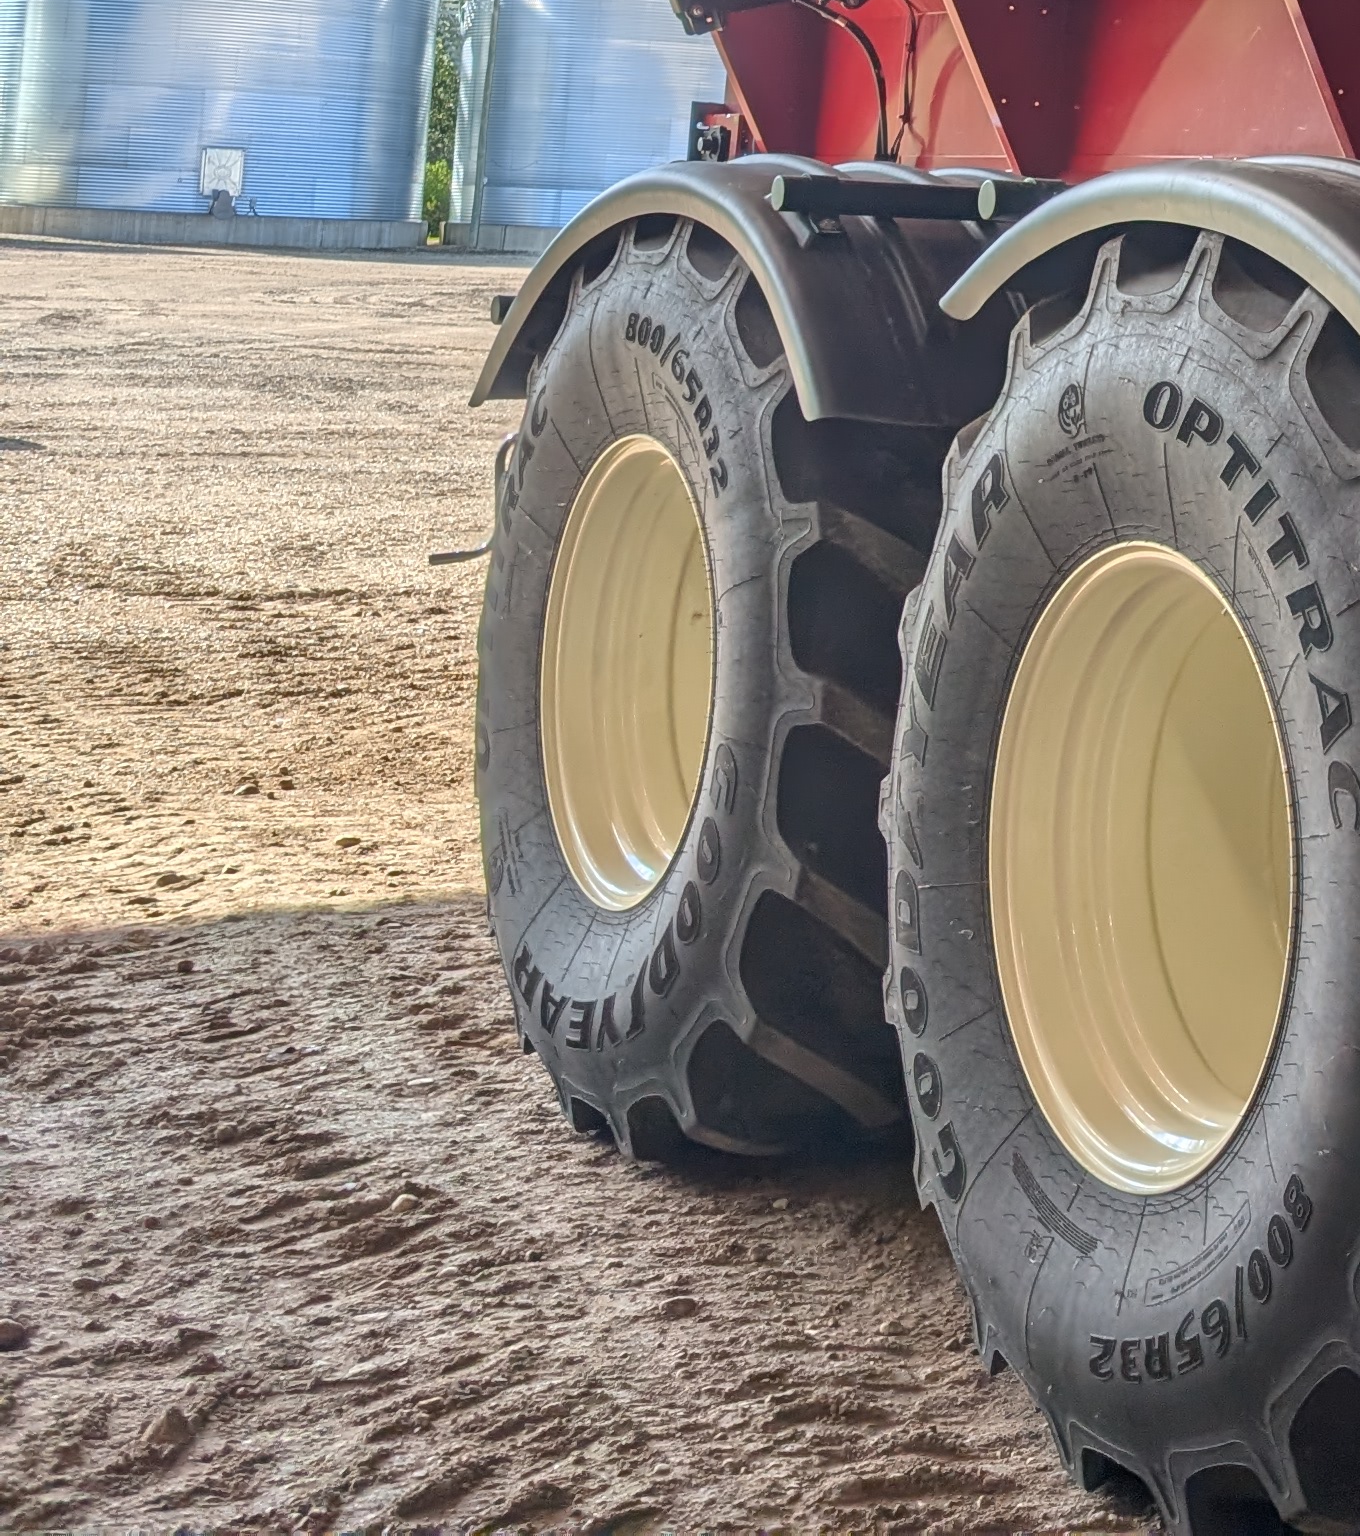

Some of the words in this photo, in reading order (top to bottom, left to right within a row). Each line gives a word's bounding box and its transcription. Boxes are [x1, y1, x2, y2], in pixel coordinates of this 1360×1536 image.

[625, 312, 729, 499] 800/65R32
[513, 742, 737, 1053] GOODYEAR
[895, 452, 1009, 1204] GOODYEAR
[1089, 1173, 1312, 1375] 800/65R32
